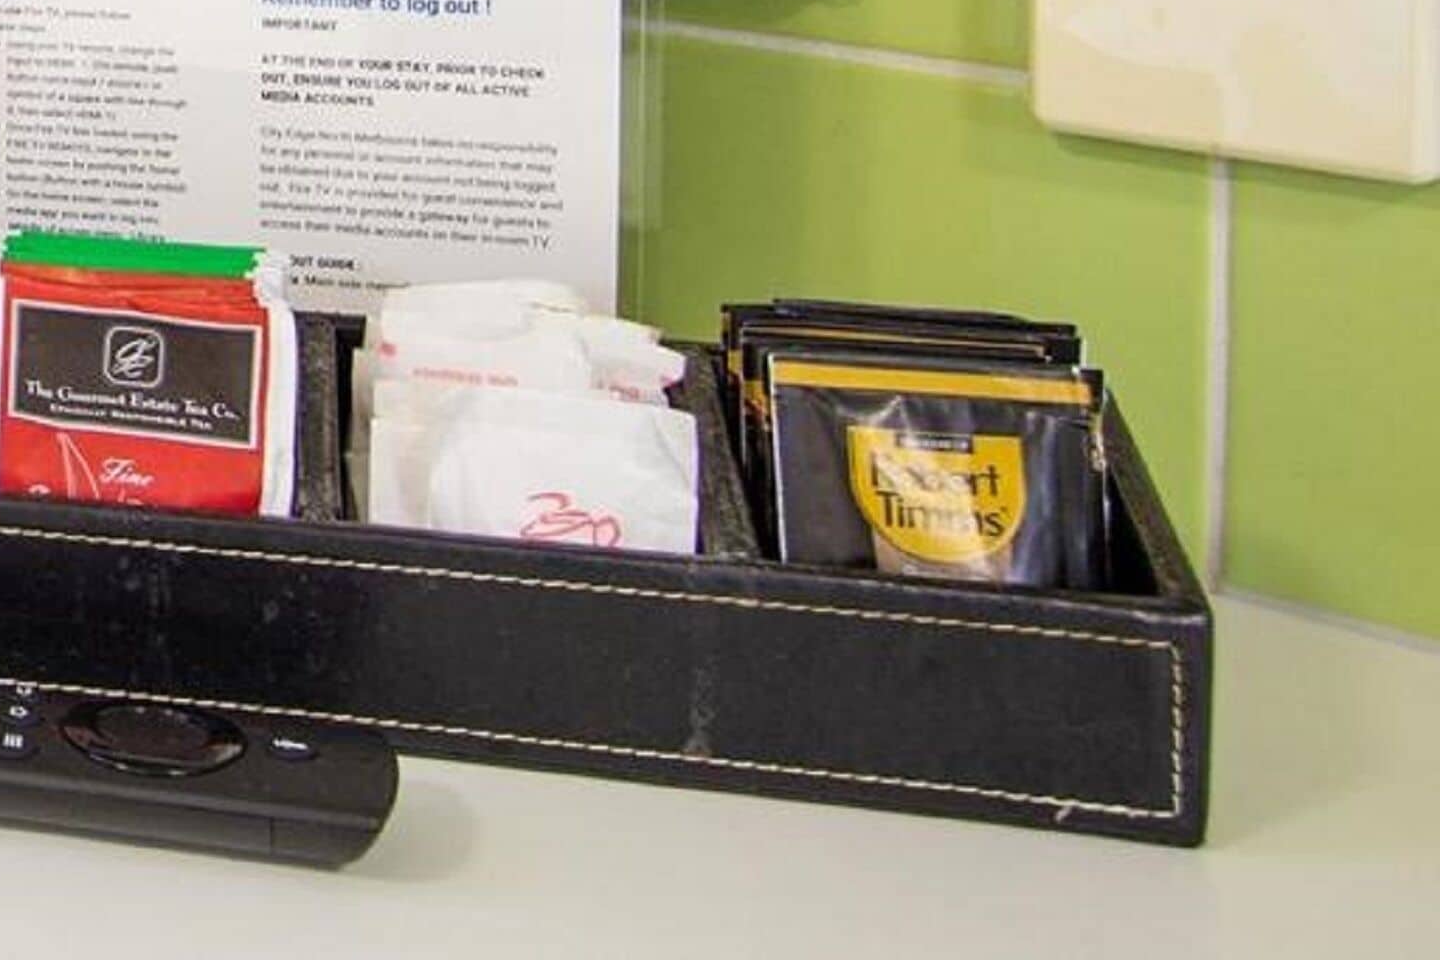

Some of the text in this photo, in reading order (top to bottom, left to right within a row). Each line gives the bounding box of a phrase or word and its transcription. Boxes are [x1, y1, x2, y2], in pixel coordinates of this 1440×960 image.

[262, 18, 338, 31] IMPORTANT
[25, 380, 53, 399] The
[58, 386, 126, 407] Gourmet
[131, 392, 177, 414] Estate
[182, 399, 208, 416] Tea
[100, 458, 155, 487] Fine
